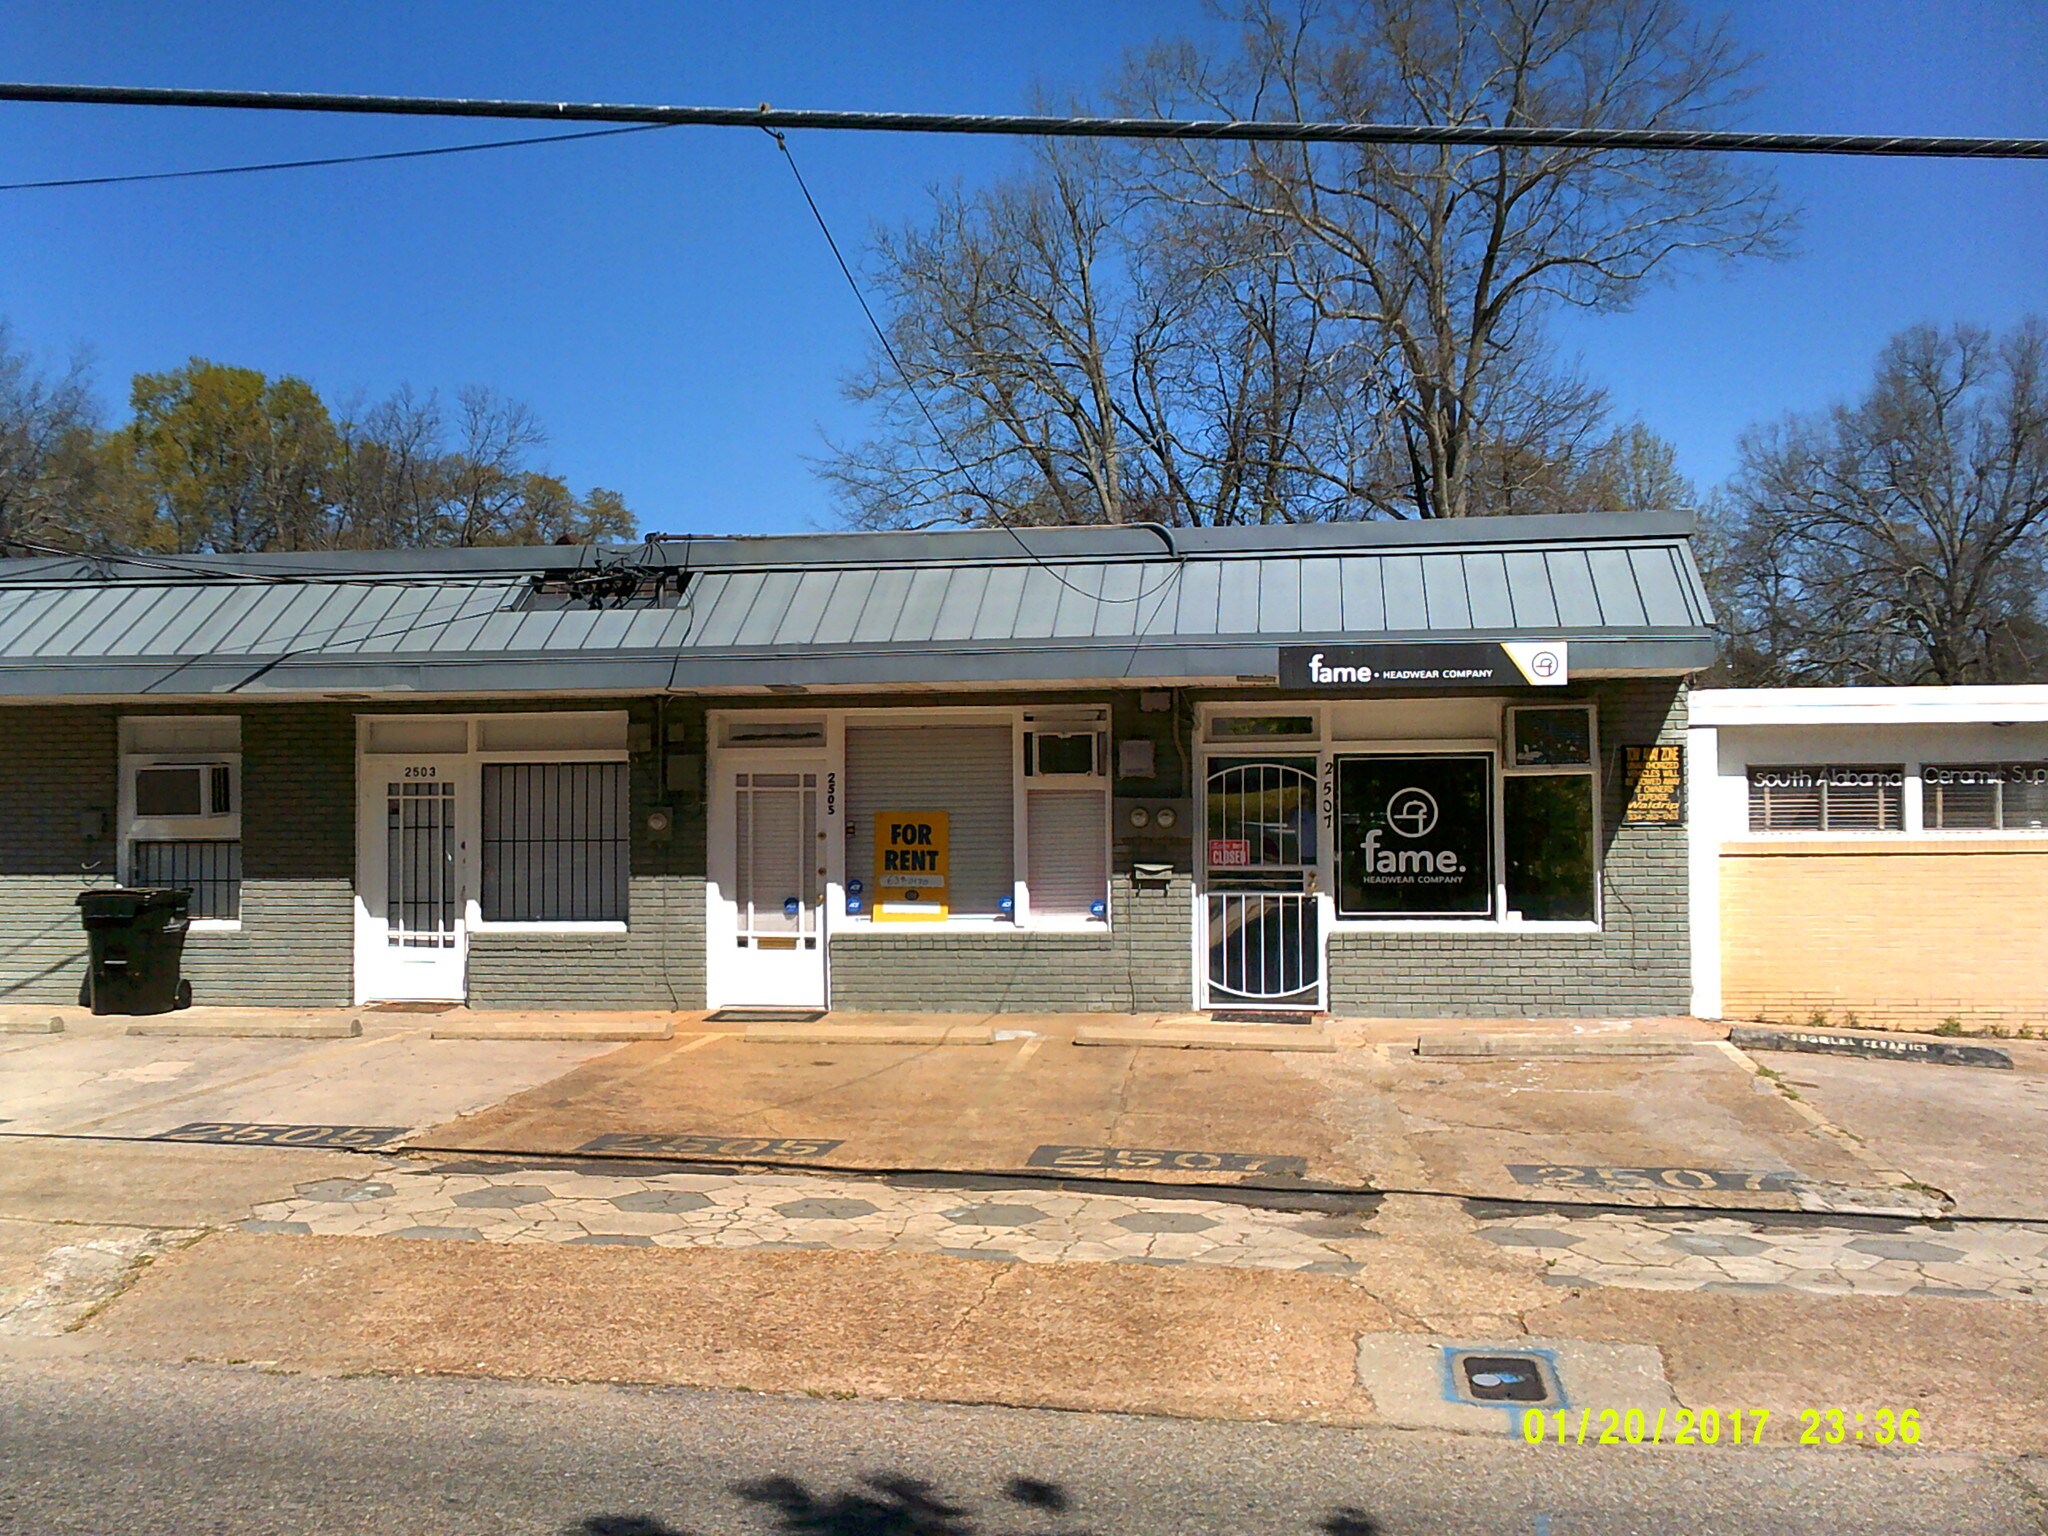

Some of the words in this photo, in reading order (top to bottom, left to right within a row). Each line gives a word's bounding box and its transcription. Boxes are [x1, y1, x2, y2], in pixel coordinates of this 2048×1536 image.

[1309, 653, 1371, 683] fame
[1383, 670, 1439, 680] HEADWEAR
[1442, 668, 1493, 679] COMPANY
[404, 766, 436, 778] 2503
[1754, 769, 1812, 787] South
[1816, 768, 1903, 787] Alabama
[1924, 767, 2006, 785] Ceramic
[827, 772, 836, 815] 2505
[1323, 762, 1333, 828] 2507
[1627, 801, 1680, 810] Waldrip
[891, 823, 933, 846] FOR
[884, 850, 939, 871] RENT
[1212, 850, 1247, 864] CLOSED
[1360, 829, 1467, 873] fame.
[1363, 876, 1415, 884] HEADWEAR
[1417, 876, 1463, 884] COMPANY
[168, 1124, 395, 1145] 2505
[601, 1135, 831, 1155] 2505
[1053, 1149, 1270, 1171] 2507
[1536, 1166, 1774, 1190] 2507
